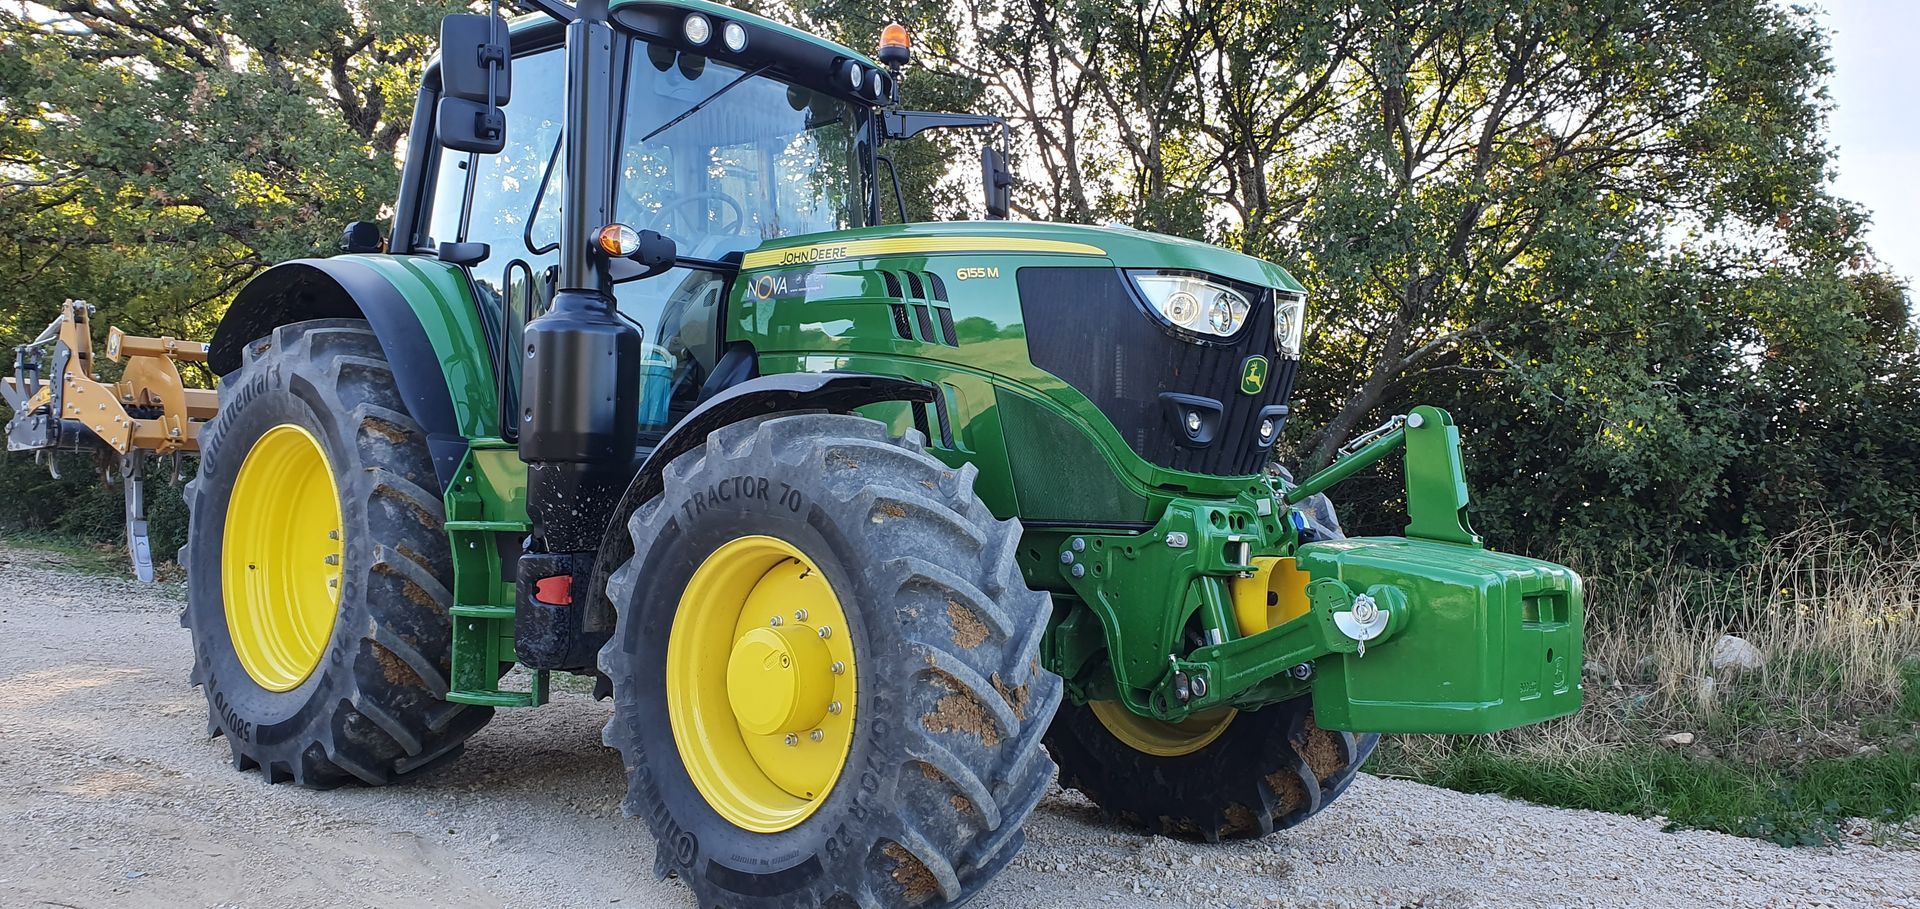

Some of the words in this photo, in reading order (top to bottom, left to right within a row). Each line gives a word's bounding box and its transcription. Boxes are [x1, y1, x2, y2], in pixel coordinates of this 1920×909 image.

[780, 251, 809, 264] JOHN
[810, 247, 847, 260] DEERE
[746, 275, 788, 300] NOVA
[956, 267, 986, 280] 6155
[986, 267, 999, 278] M
[203, 365, 271, 480] Continental
[680, 475, 769, 521] TRACTOR
[779, 482, 802, 513] 70
[214, 691, 251, 743] 580/70
[848, 797, 868, 823] R
[825, 822, 853, 862] 28
